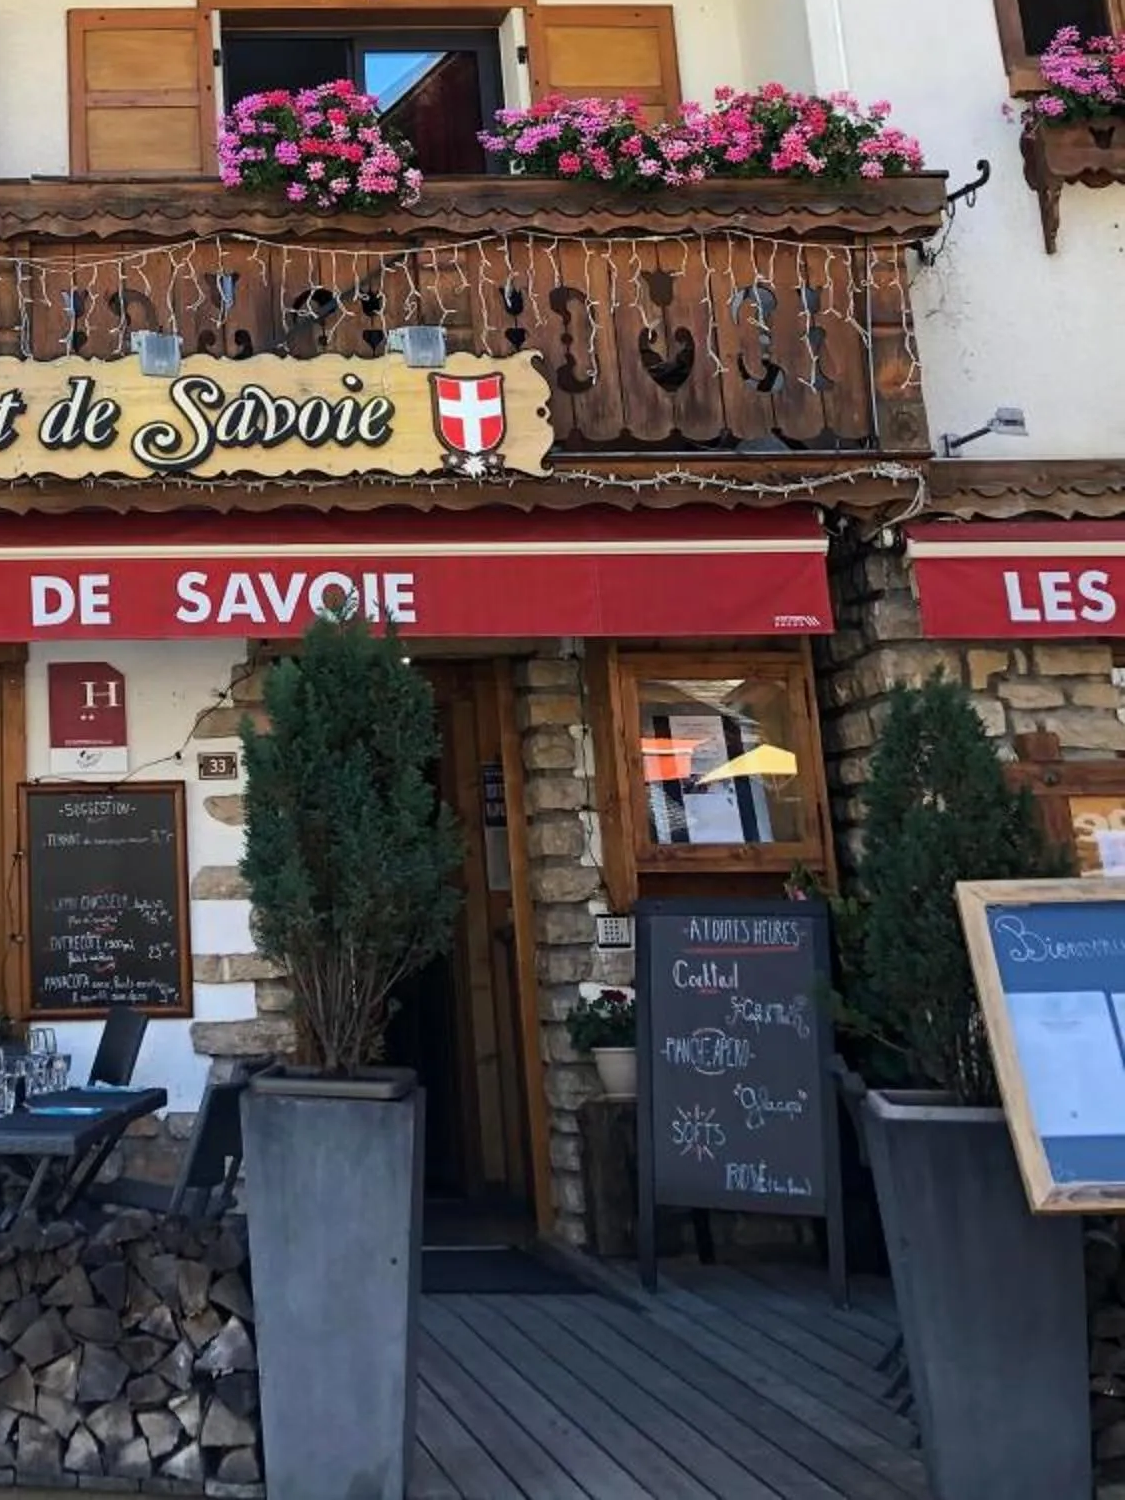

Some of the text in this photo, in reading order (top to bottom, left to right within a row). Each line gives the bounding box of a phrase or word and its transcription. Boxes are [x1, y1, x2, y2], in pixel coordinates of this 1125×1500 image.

[39, 376, 120, 449] de
[131, 373, 395, 472] Savoie
[30, 574, 111, 626] DE
[176, 571, 416, 624] SAVOIE
[1003, 570, 1116, 622] LES
[80, 681, 121, 708] H
[210, 760, 226, 773] 33
[672, 1120, 726, 1145] SOFTS
